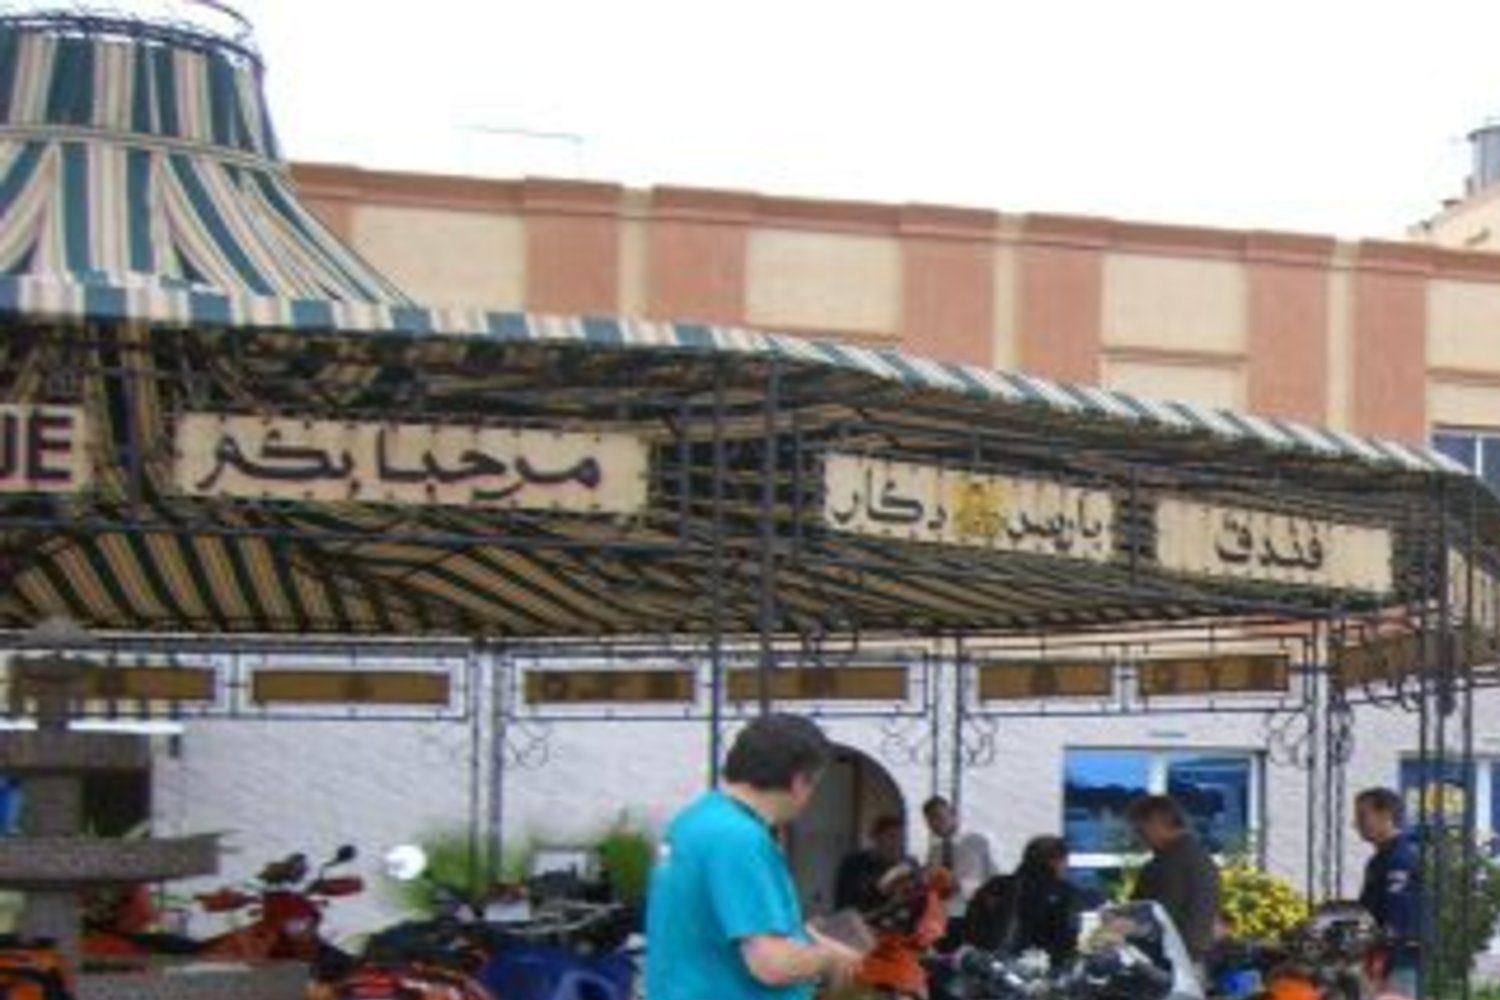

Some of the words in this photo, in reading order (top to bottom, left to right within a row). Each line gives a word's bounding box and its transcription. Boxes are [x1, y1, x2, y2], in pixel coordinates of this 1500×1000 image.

[195, 428, 358, 499] بكم
[374, 428, 601, 500] مرحبا
[832, 467, 947, 531] دكار
[1214, 516, 1323, 571] فندق
